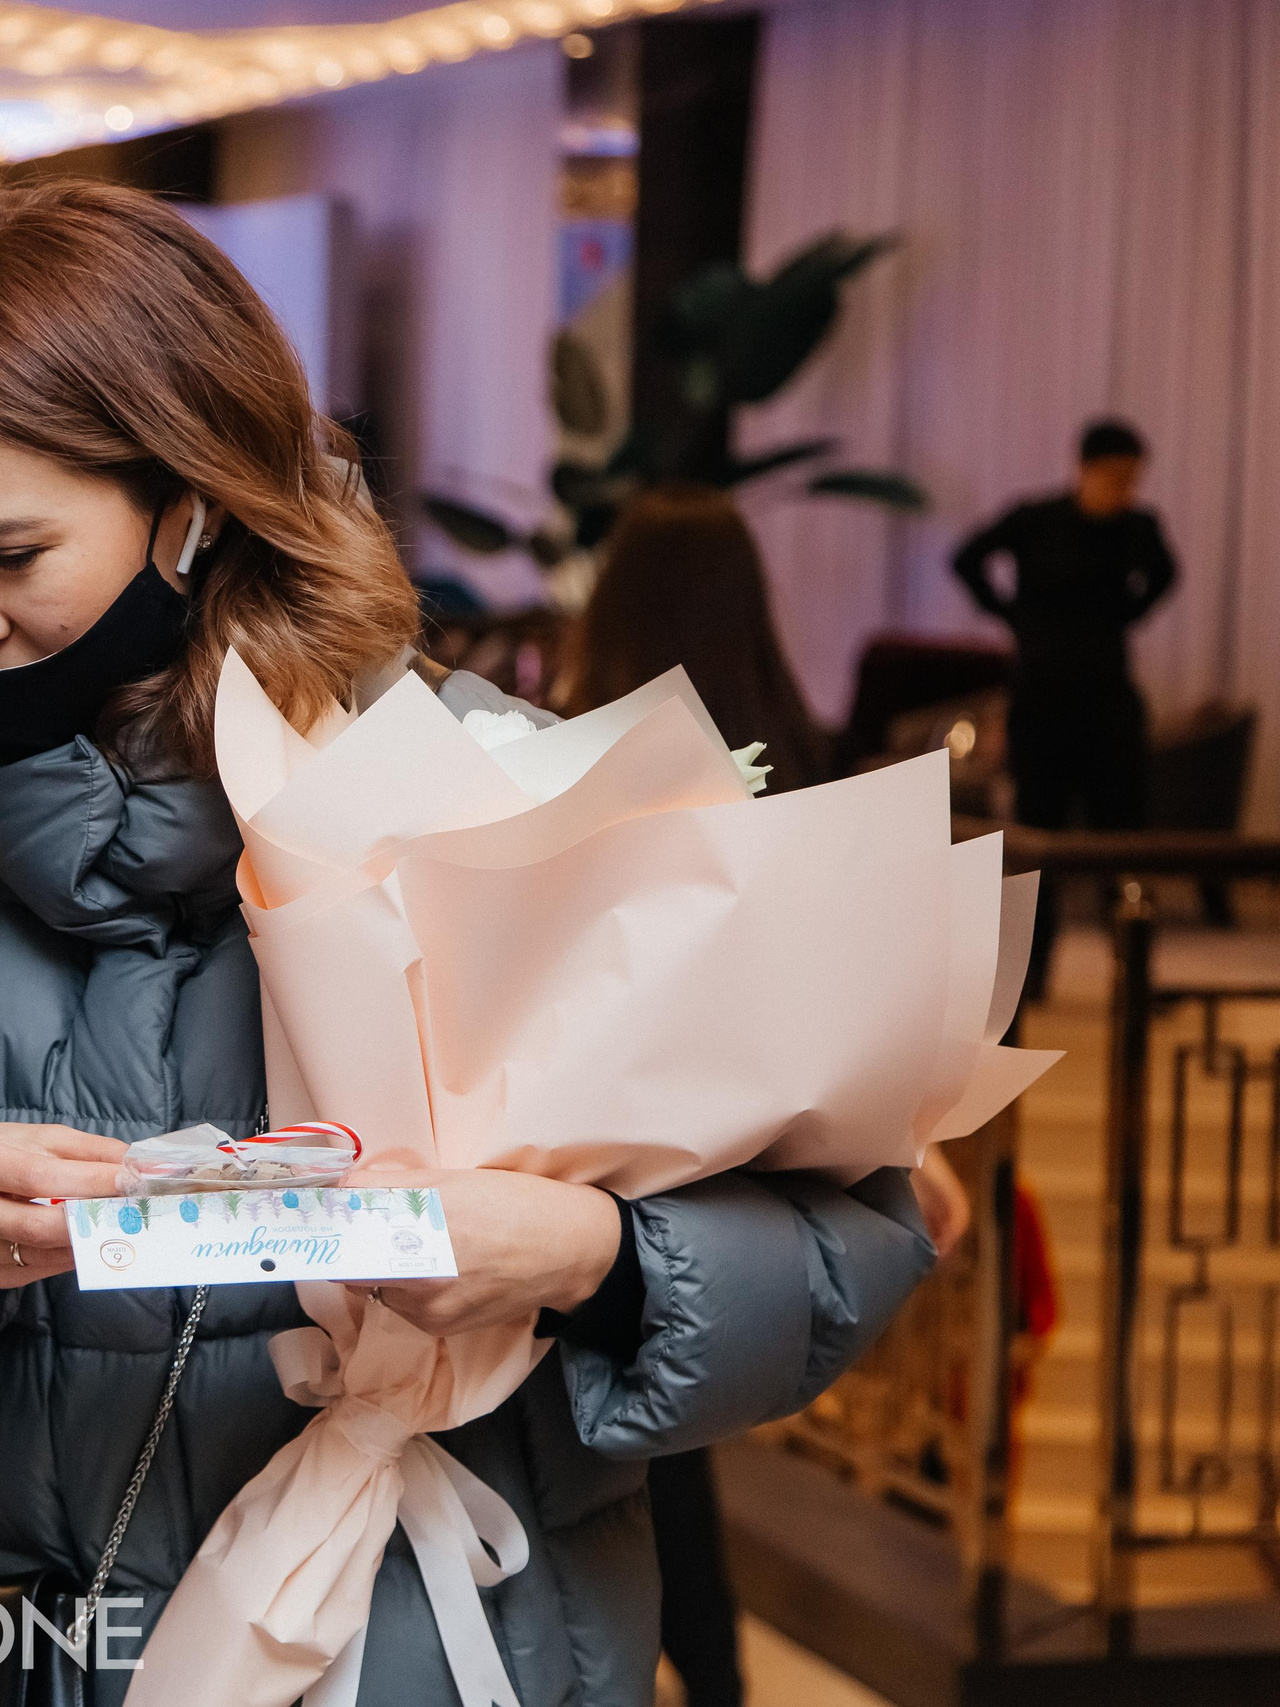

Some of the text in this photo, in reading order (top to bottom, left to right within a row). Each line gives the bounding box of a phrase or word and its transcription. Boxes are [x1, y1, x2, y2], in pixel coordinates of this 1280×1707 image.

[271, 1225, 316, 1233] подарок
[191, 1226, 342, 1265] Шильдики
[114, 1253, 122, 1264] 6
